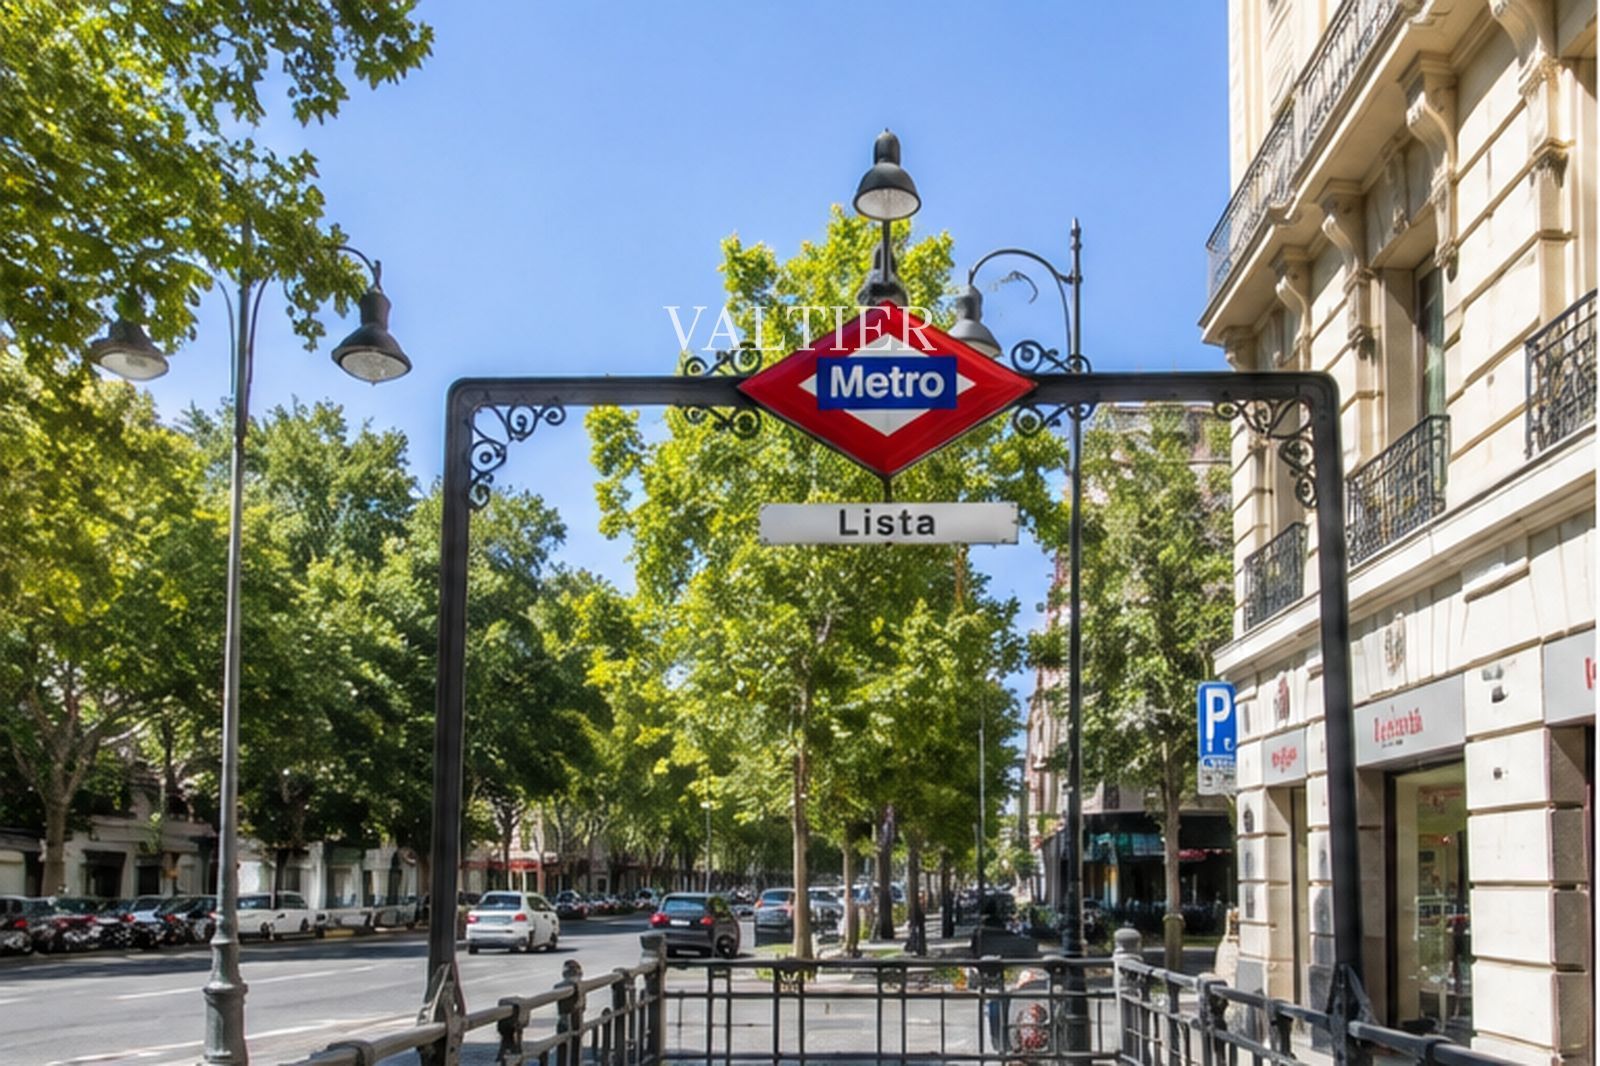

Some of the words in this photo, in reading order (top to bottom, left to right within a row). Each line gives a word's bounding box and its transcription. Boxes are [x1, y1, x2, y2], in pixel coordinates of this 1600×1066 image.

[830, 365, 945, 399] Metro
[839, 509, 935, 536] Lista
[1206, 688, 1232, 742] P
